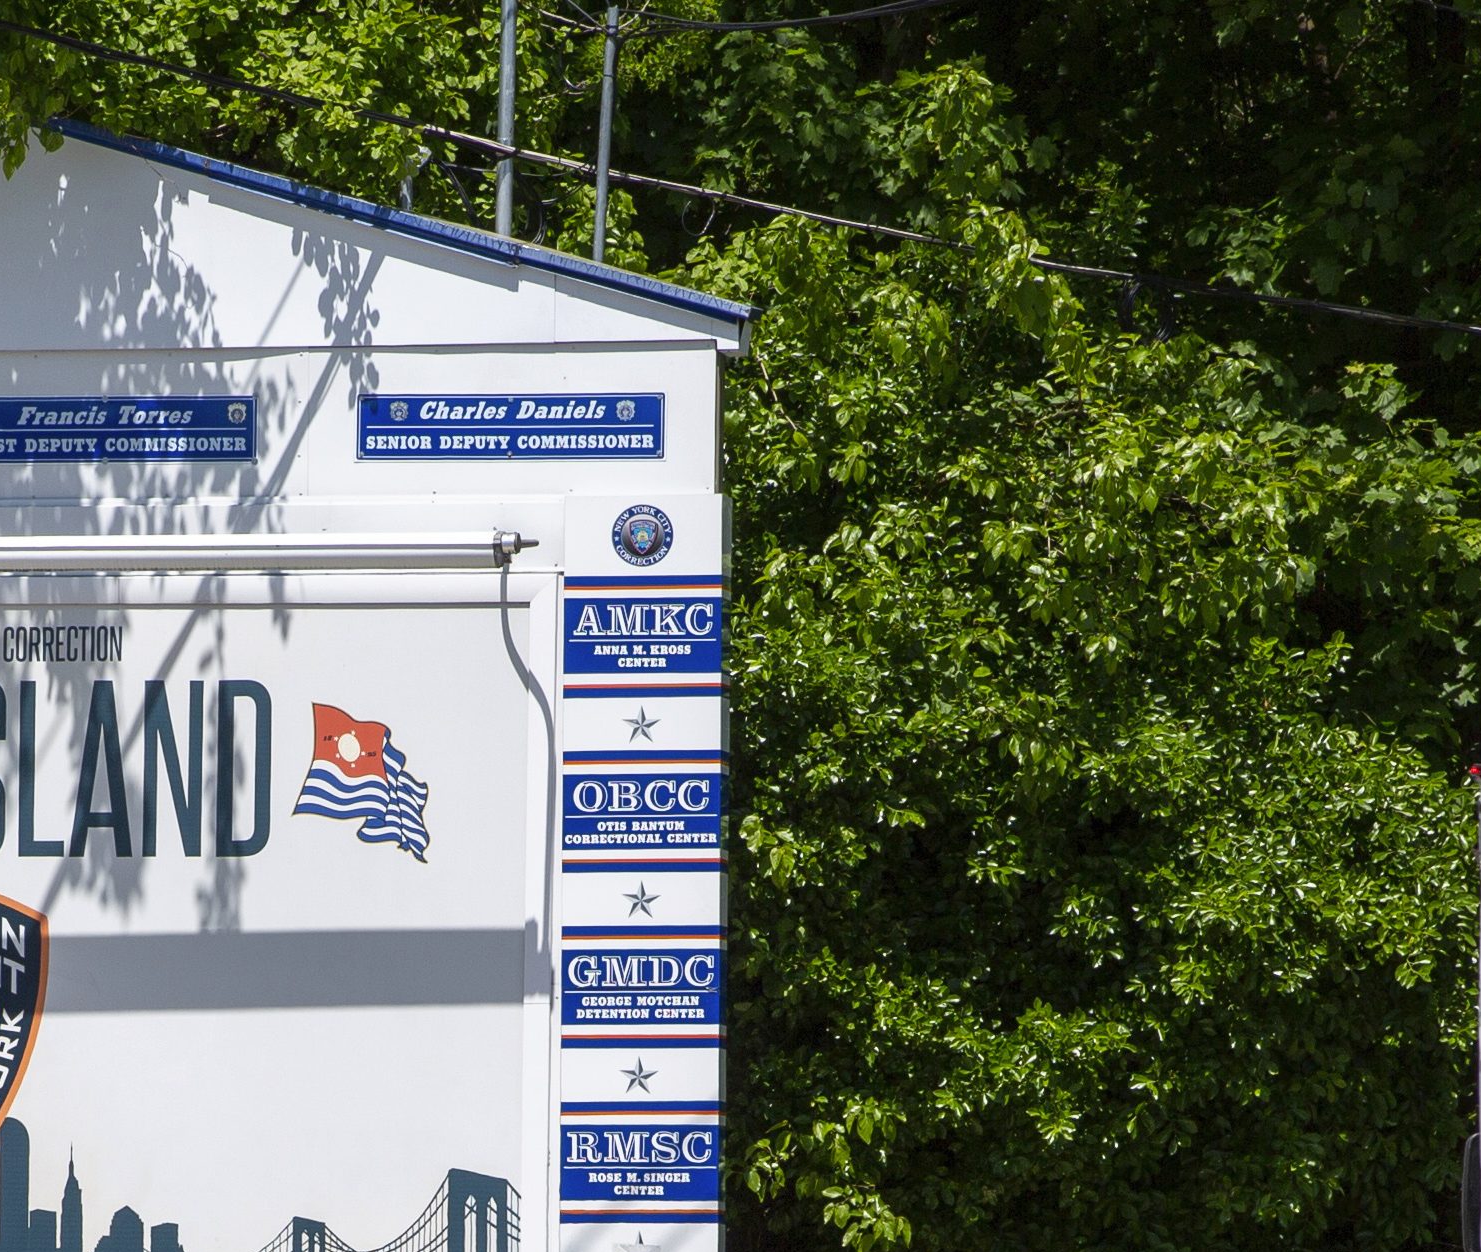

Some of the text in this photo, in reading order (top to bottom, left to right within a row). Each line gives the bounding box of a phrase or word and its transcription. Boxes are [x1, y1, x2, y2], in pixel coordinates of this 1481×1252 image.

[17, 405, 193, 425] Francis Torres
[419, 399, 606, 420] Charles Daniels
[24, 438, 98, 453] DEPUTY
[105, 437, 247, 452] COMMISSIONER
[366, 434, 654, 450] SENIOR DEPUTY COMMISSIONER
[614, 506, 672, 533] NEW YORK CITY
[616, 545, 668, 566] CORRECTION
[573, 603, 714, 636] AMKC
[2, 625, 123, 663] CORRECTION
[593, 645, 691, 655] ANNA M. KROSS
[618, 657, 667, 668] CENTER
[573, 780, 710, 812] OBCC
[597, 821, 685, 831] OTIS BANTUM
[565, 833, 717, 844] CORRECTIONAL CENTER
[568, 954, 715, 988] GMDC
[582, 996, 700, 1006] GEORGE MOTCHAN
[576, 1008, 705, 1019] DETENTION CENTER
[566, 1131, 712, 1164] RMSC
[588, 1172, 690, 1183] ROSE M. SINGER
[613, 1185, 664, 1195] CENTER
